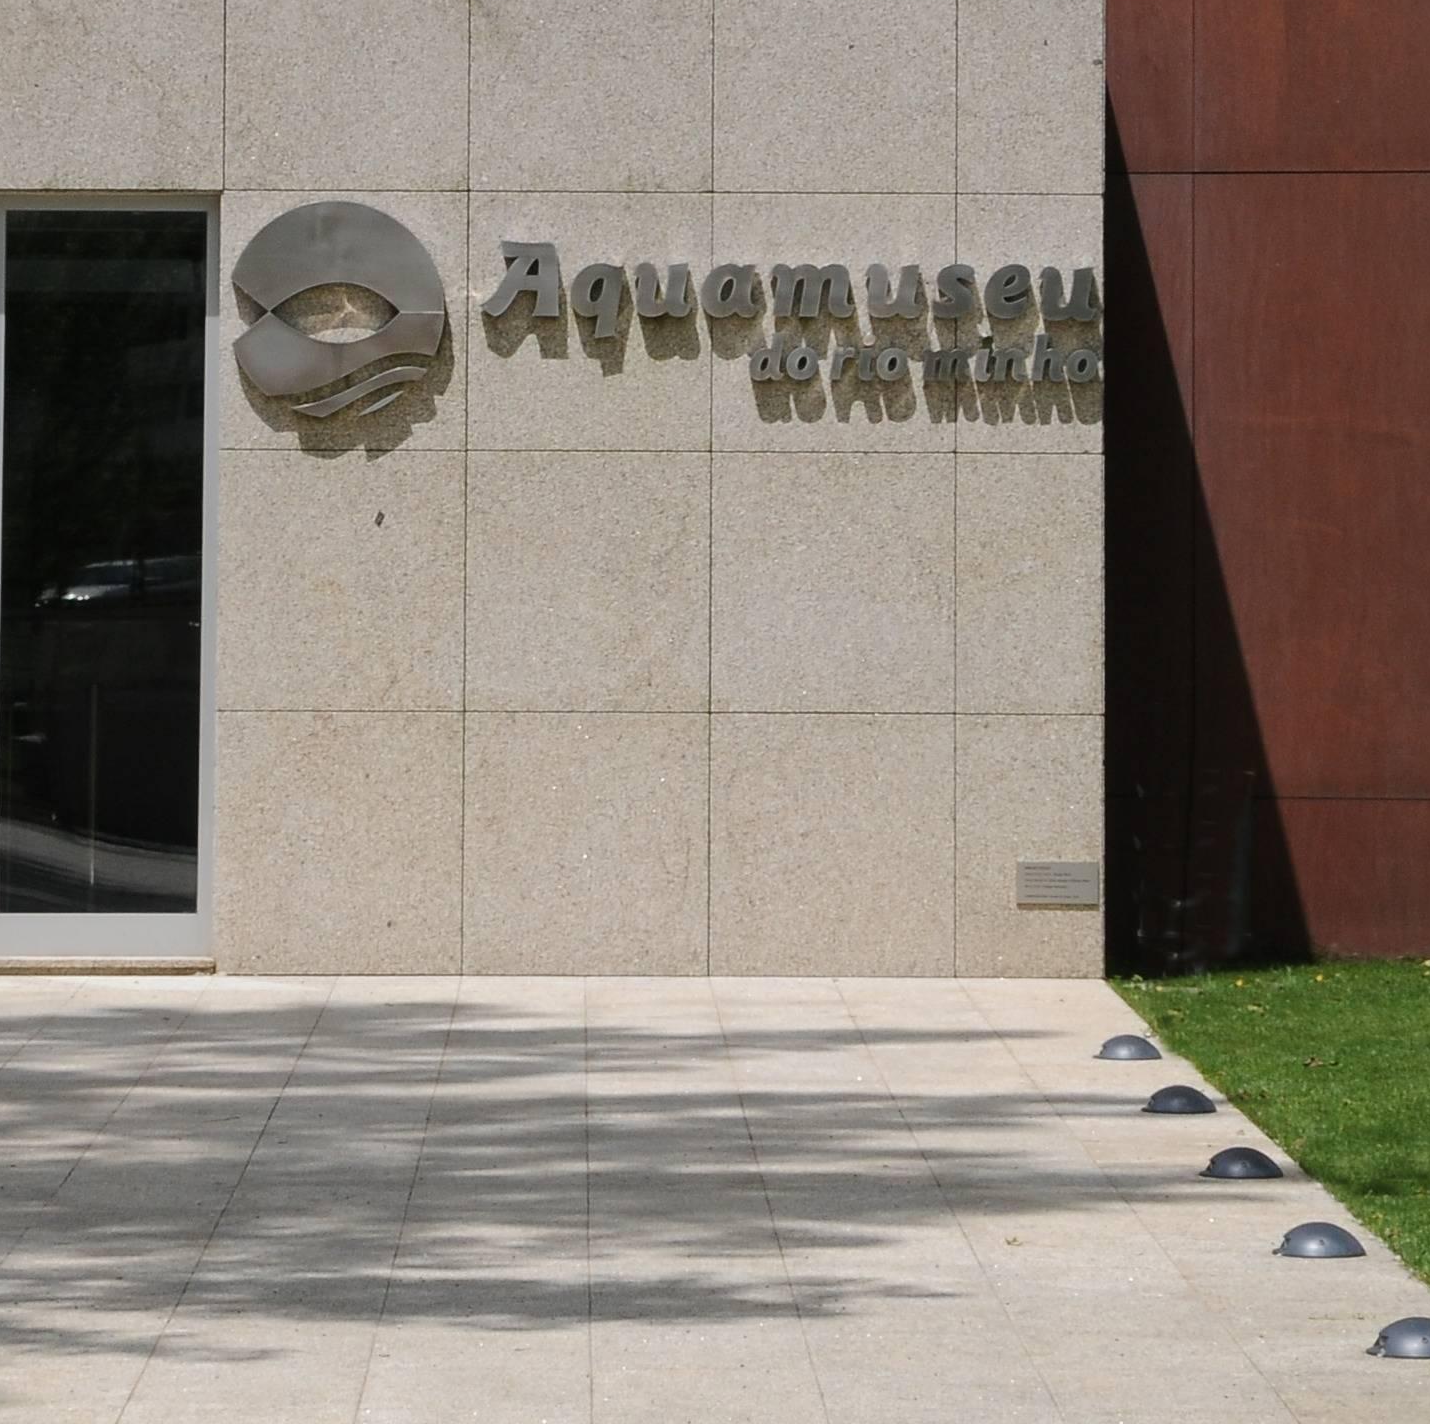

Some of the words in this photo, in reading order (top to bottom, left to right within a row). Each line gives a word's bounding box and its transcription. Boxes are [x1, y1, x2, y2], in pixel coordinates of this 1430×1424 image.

[480, 240, 1100, 338] Aquamuseu
[749, 331, 819, 382] do
[830, 330, 909, 382] rio
[922, 332, 1099, 383] minho
